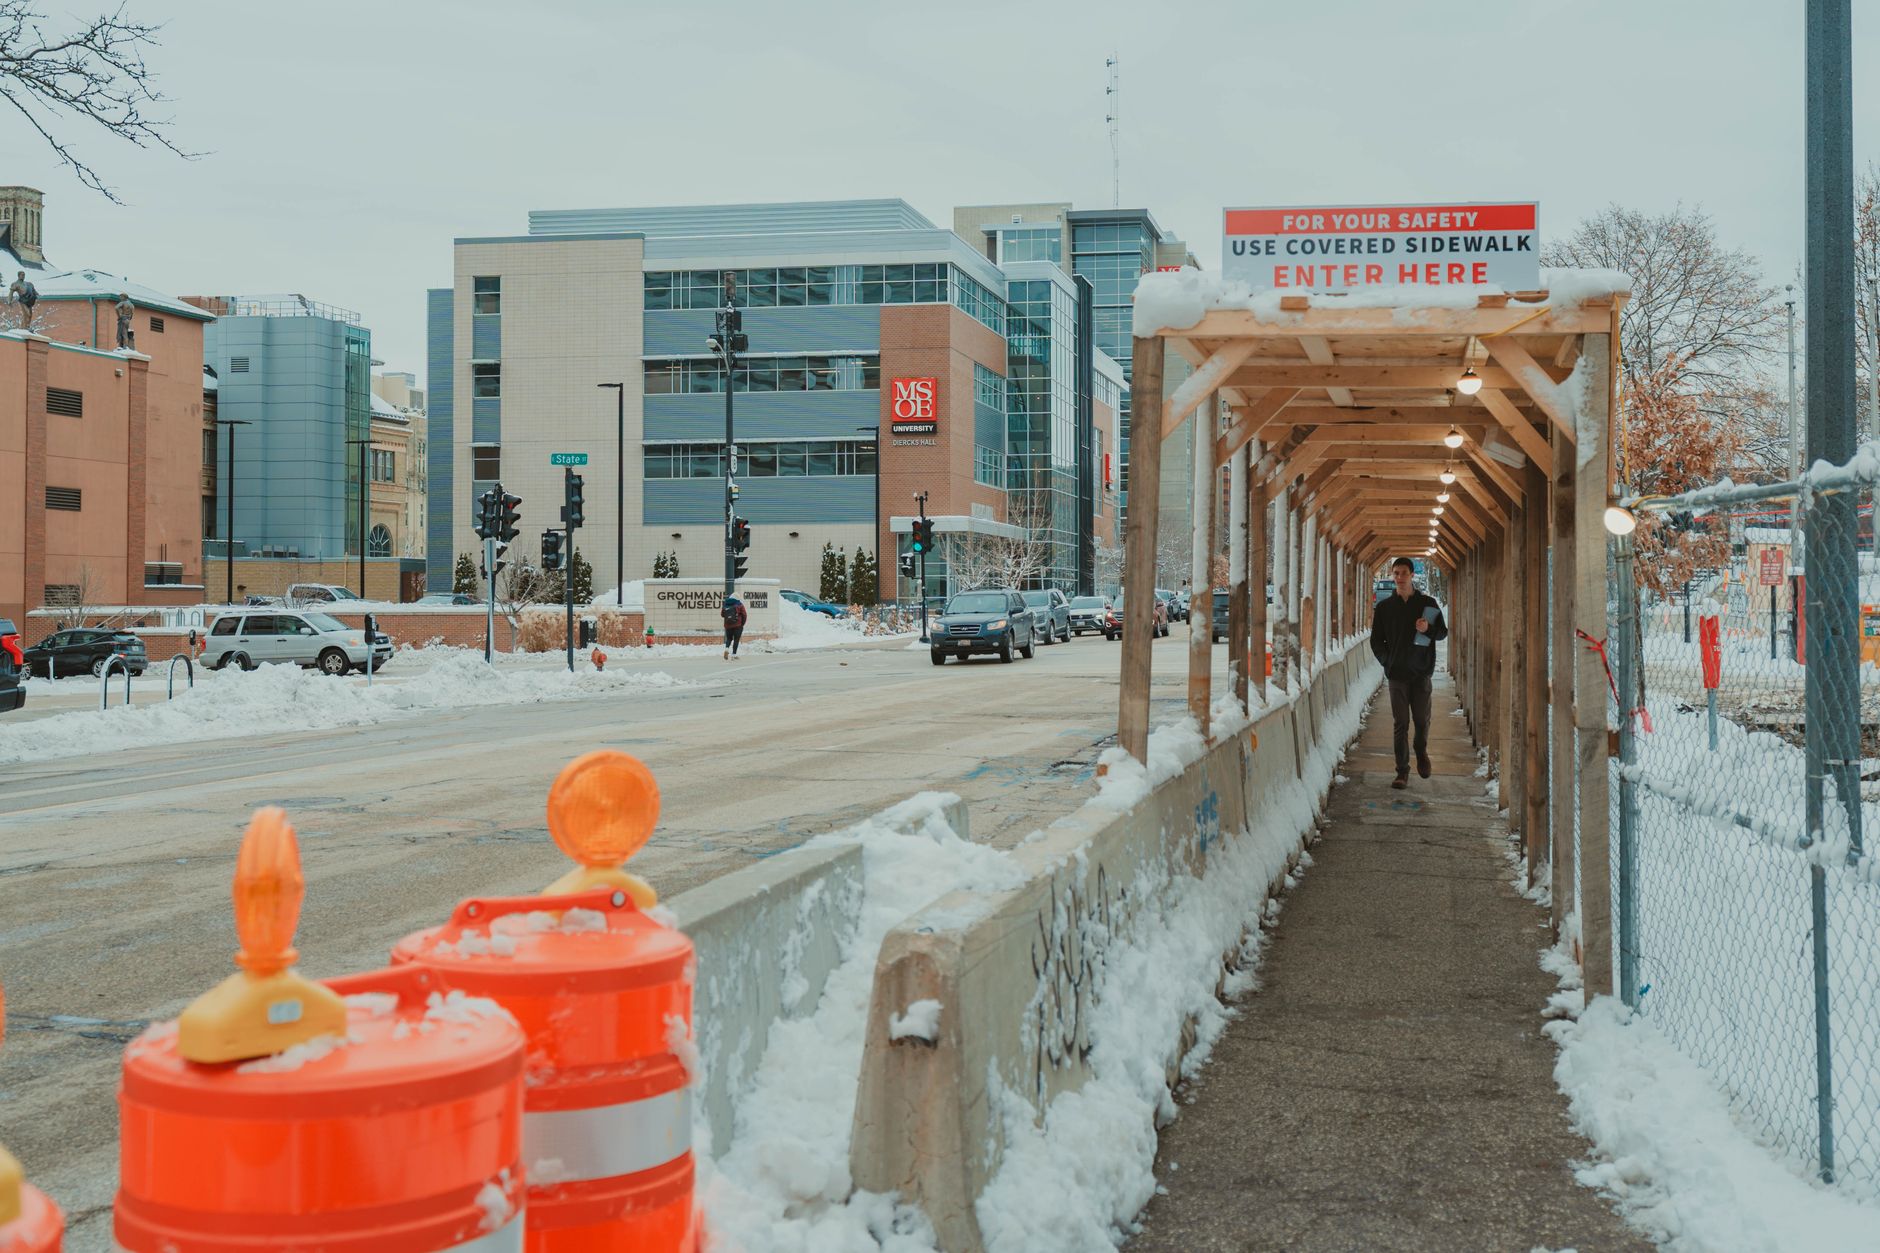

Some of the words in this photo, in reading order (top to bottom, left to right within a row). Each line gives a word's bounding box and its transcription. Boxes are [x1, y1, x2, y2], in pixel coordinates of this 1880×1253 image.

[1283, 214, 1325, 230] FOR
[1333, 213, 1391, 230] YOUR
[1397, 211, 1479, 228] SAFETY
[1232, 239, 1276, 256] USE
[1286, 237, 1396, 256] COVERED
[1405, 235, 1531, 254] SIDEWALK
[1274, 263, 1384, 288] ENTER
[1398, 262, 1488, 286] HERE
[894, 381, 933, 401] MS
[894, 398, 933, 418] OE
[556, 454, 580, 464] State
[657, 592, 725, 601] GROHMAN
[677, 601, 725, 609] MUSEU
